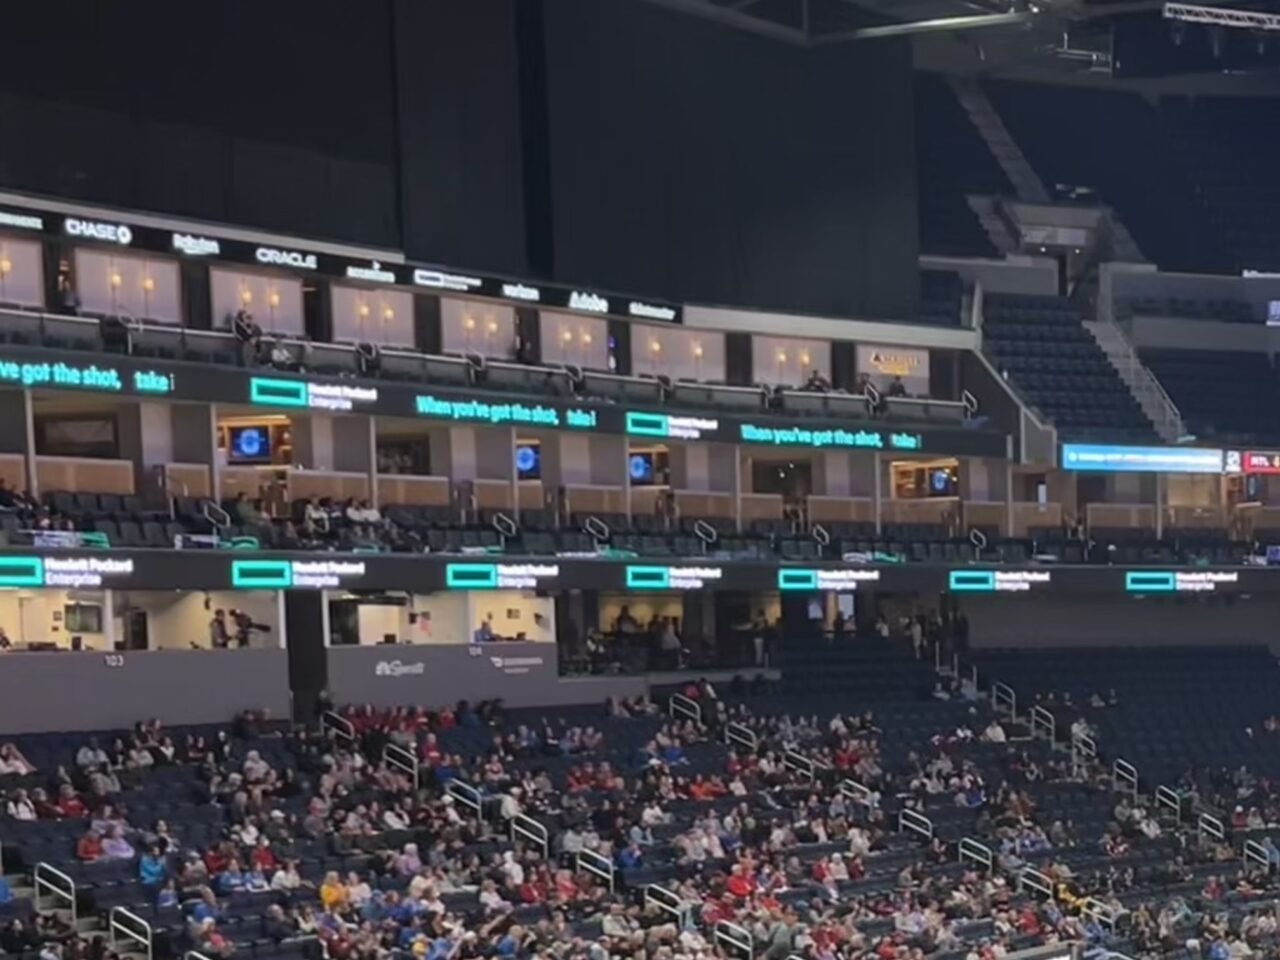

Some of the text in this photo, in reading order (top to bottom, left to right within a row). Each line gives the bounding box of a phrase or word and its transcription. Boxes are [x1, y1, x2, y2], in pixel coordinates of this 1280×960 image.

[65, 218, 117, 241] CHASE
[255, 248, 317, 269] ORACLE
[22, 363, 50, 384] got
[52, 362, 81, 384] the
[82, 365, 122, 390] shot,
[134, 370, 169, 392] take
[774, 428, 811, 446] you've
[812, 430, 833, 446] got
[834, 429, 854, 445] the
